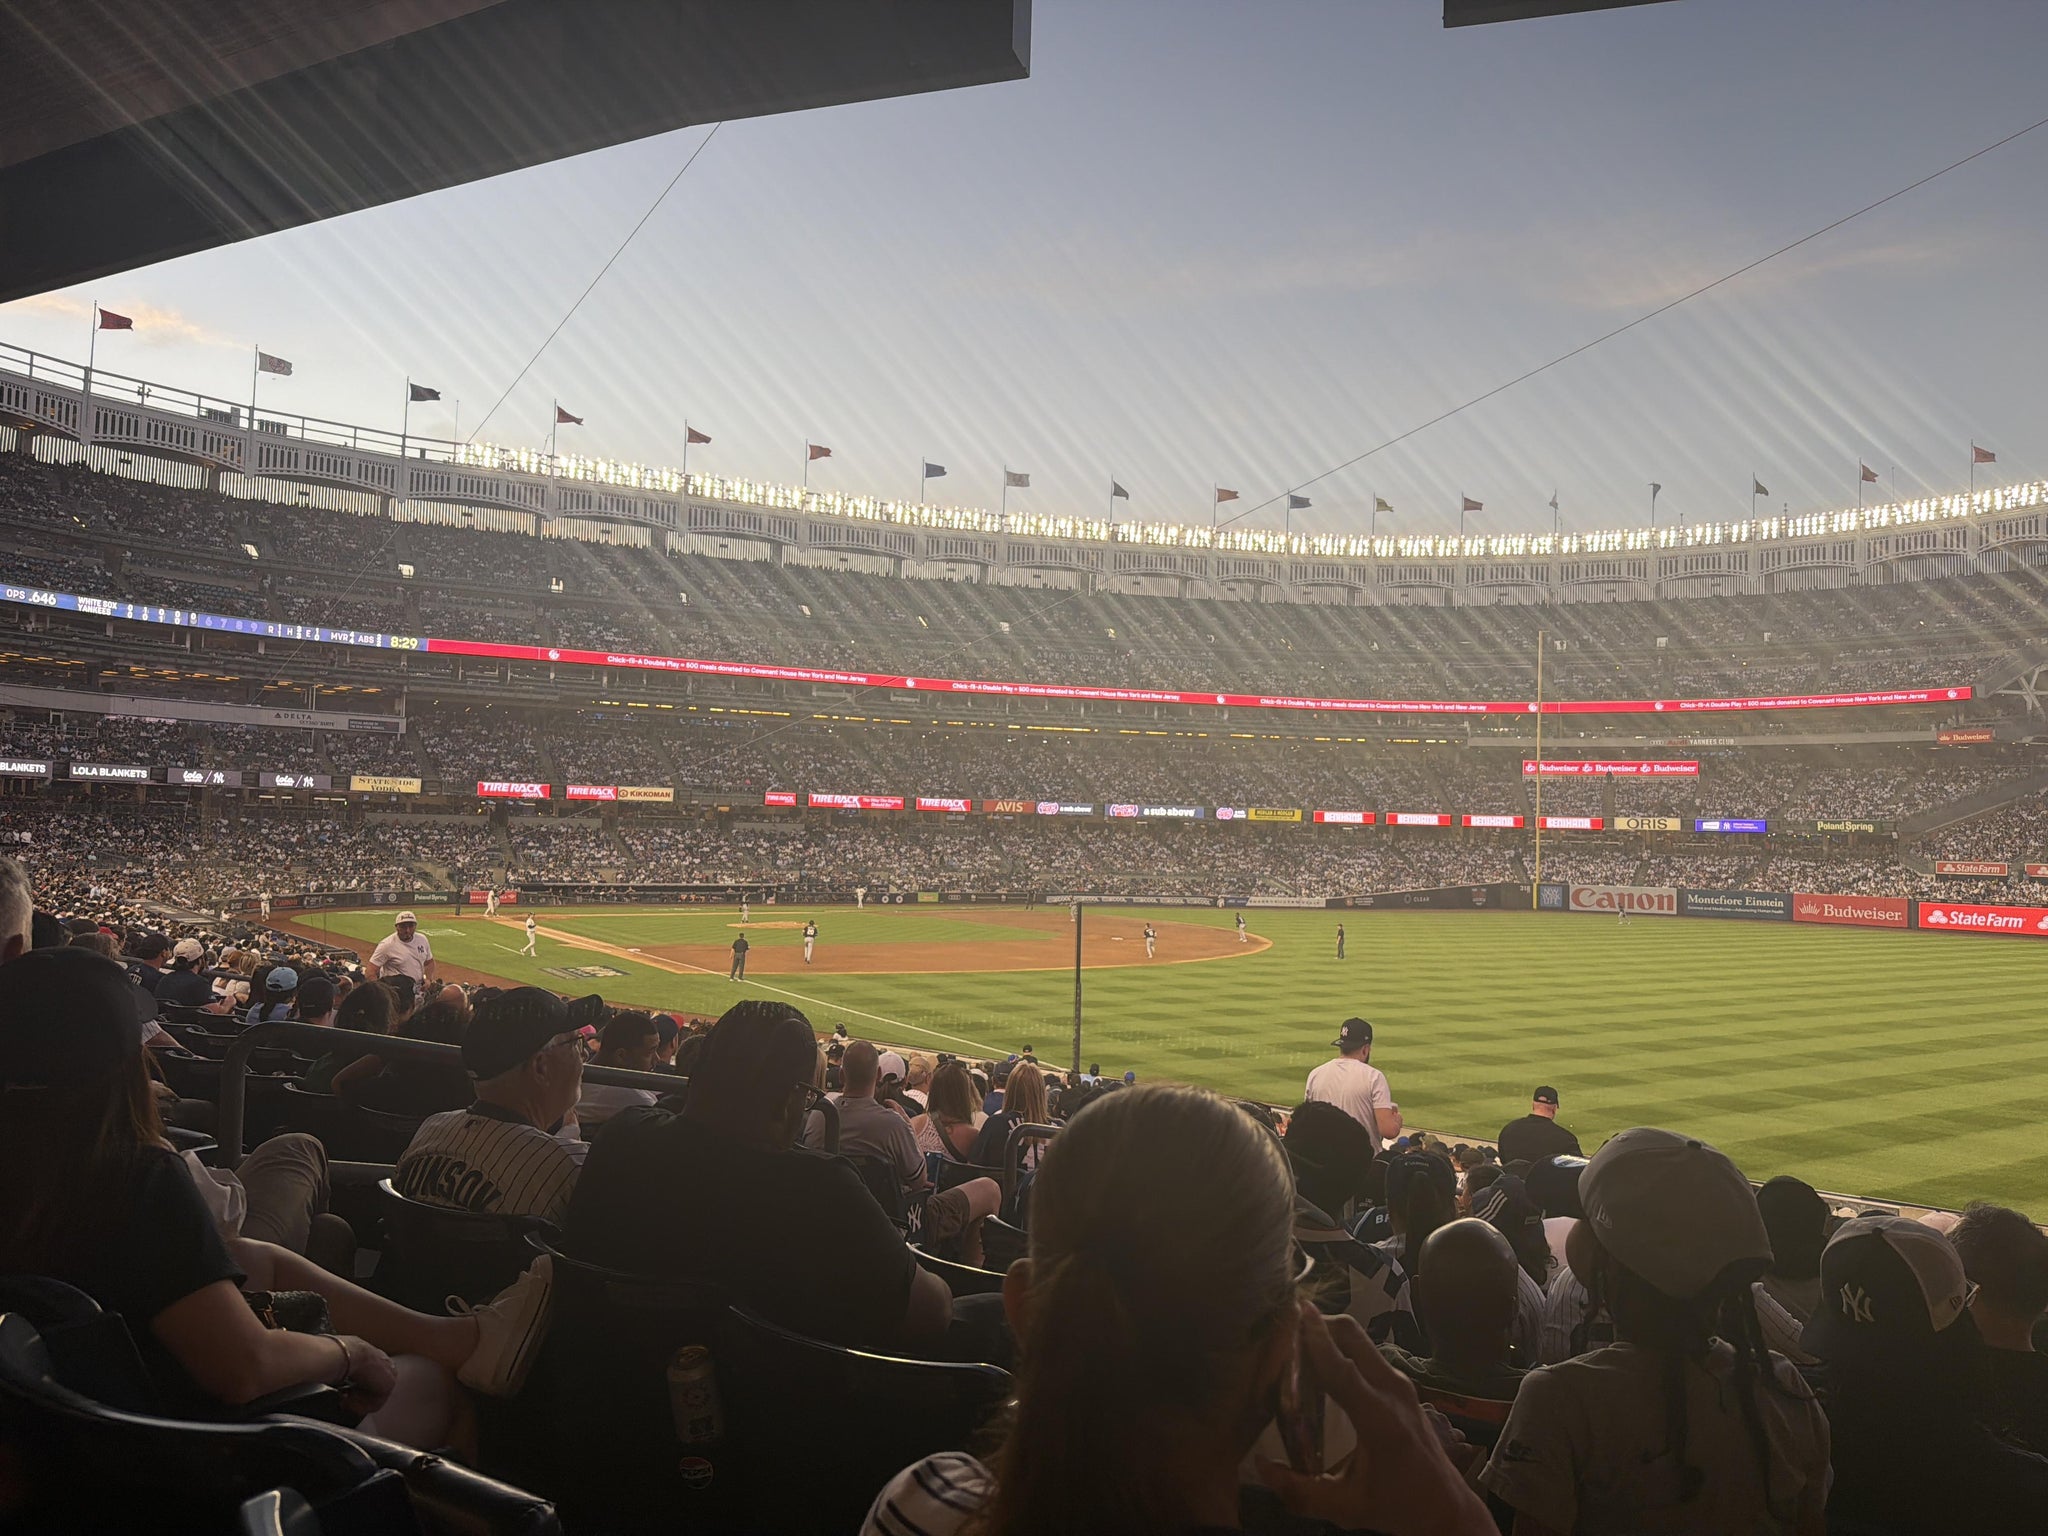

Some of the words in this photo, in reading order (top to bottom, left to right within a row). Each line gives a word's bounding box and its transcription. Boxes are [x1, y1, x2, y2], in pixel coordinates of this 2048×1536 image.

[6, 588, 26, 600] OPS
[28, 592, 57, 605] .646
[78, 596, 102, 607] WHITE
[103, 601, 117, 609] SOX
[78, 604, 111, 615] YANKEES
[206, 617, 212, 626] 6
[221, 619, 227, 628] 7
[236, 620, 243, 629] 8
[251, 622, 258, 632] 9
[331, 632, 348, 641] MVR
[358, 635, 374, 643] ABS
[391, 636, 418, 649] 8:29
[644, 658, 666, 666] Double
[667, 660, 679, 669] Play
[686, 661, 698, 669] 500
[700, 662, 717, 670] meals
[718, 664, 743, 672] donated
[779, 668, 797, 677] House
[798, 670, 811, 678] New
[812, 671, 823, 679] York
[824, 672, 835, 680] and
[836, 673, 848, 681] New
[849, 675, 867, 684] Jersey
[0, 763, 46, 773] BLANKETS
[72, 766, 97, 775] LOLA
[100, 768, 147, 778] BLANKETS
[1595, 764, 1637, 772] Budweiser
[1654, 764, 1696, 772] Budweiser
[482, 782, 509, 792] TIRE
[510, 784, 544, 797] RACK
[589, 788, 615, 800] RACK
[813, 795, 834, 803] TIRE
[834, 795, 860, 808] RACK
[921, 798, 941, 807] TIRE
[941, 799, 965, 811] RACK
[995, 802, 1023, 812] AVIS
[1151, 808, 1166, 816] sub
[1167, 808, 1195, 817] above
[1626, 818, 1668, 829] ORIS
[1817, 821, 1844, 830] Poland
[1846, 821, 1873, 832] Spring
[1571, 887, 1674, 912] Canon
[1688, 894, 1742, 905] Montefiore
[1745, 896, 1784, 907] Einstein
[1823, 904, 1900, 921] Budweiser
[907, 1203, 922, 1233] NY
[1839, 1282, 1876, 1323] NY
